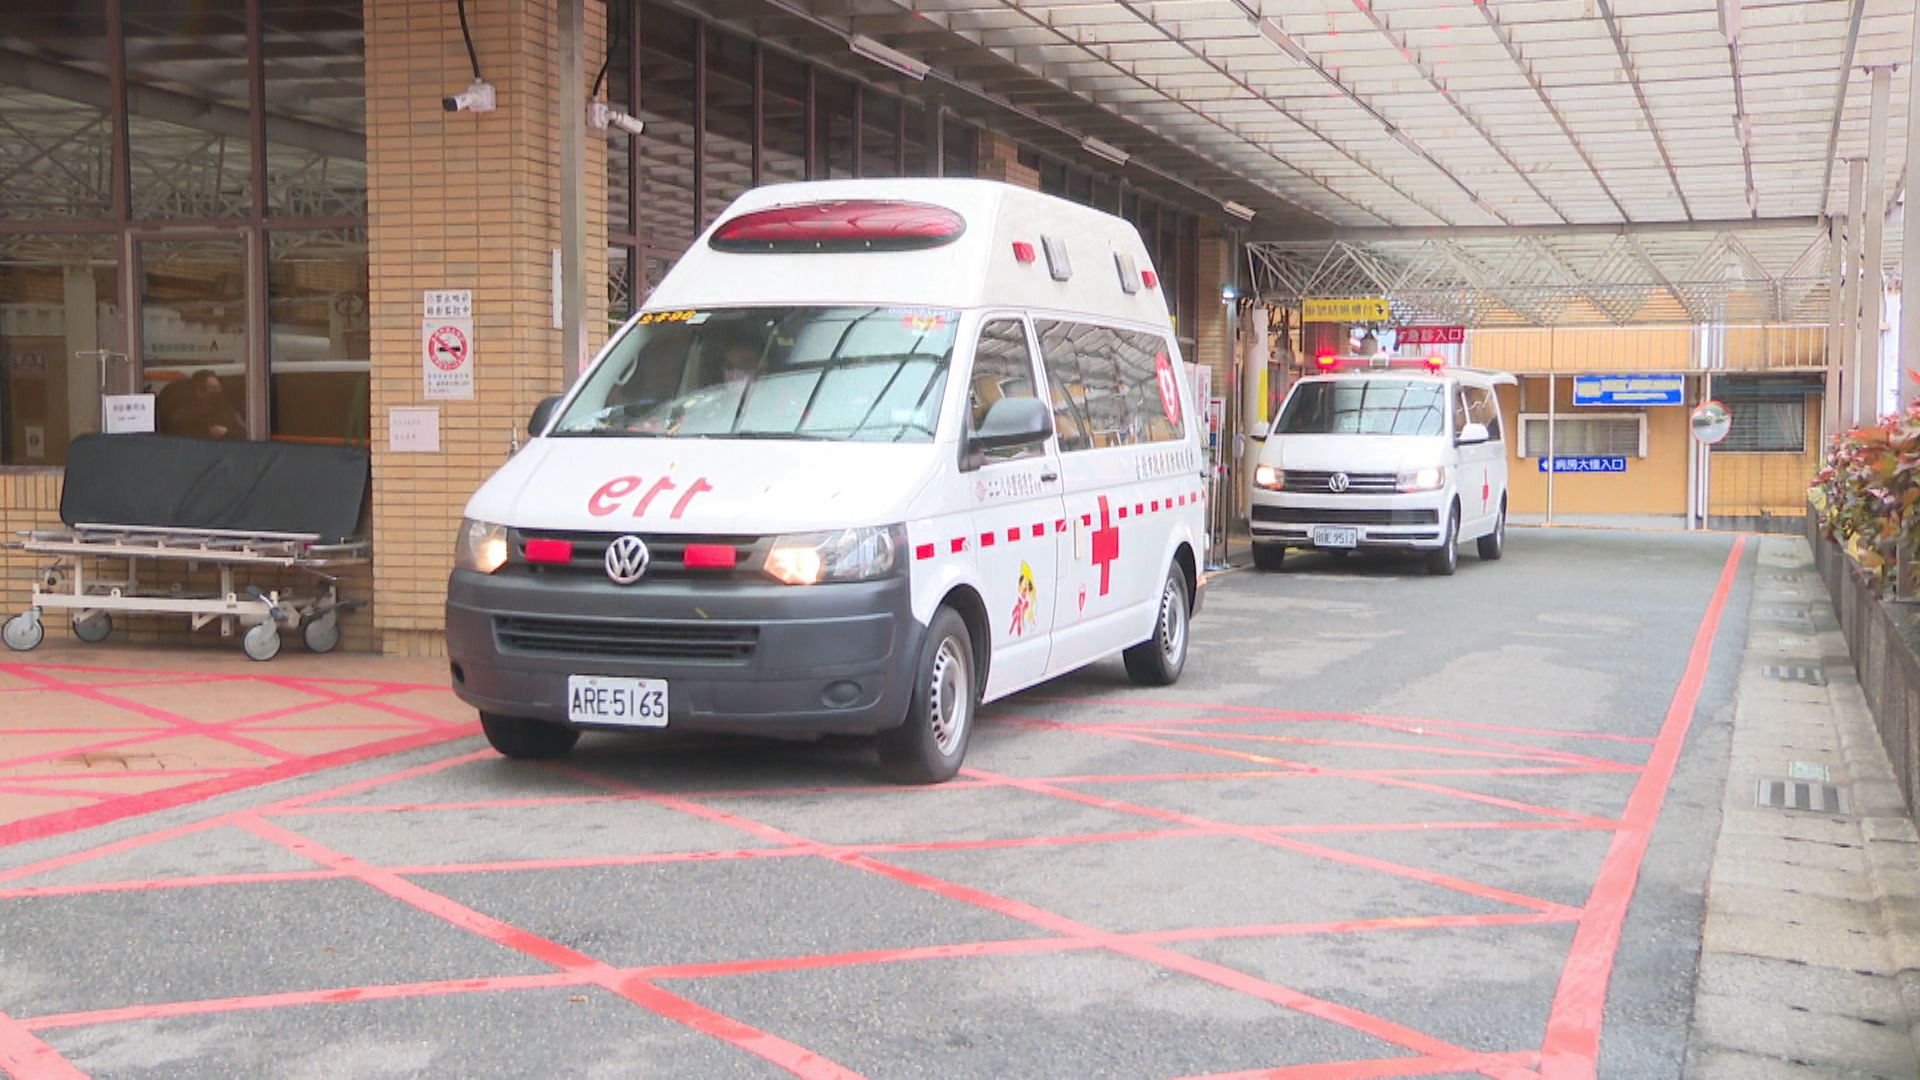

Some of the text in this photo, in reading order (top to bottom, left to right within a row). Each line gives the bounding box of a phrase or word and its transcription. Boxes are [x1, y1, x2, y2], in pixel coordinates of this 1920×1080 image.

[1407, 329, 1461, 342] 急診入口
[1555, 459, 1624, 471] 病房大樓入口
[571, 686, 665, 719] ARE-5163
